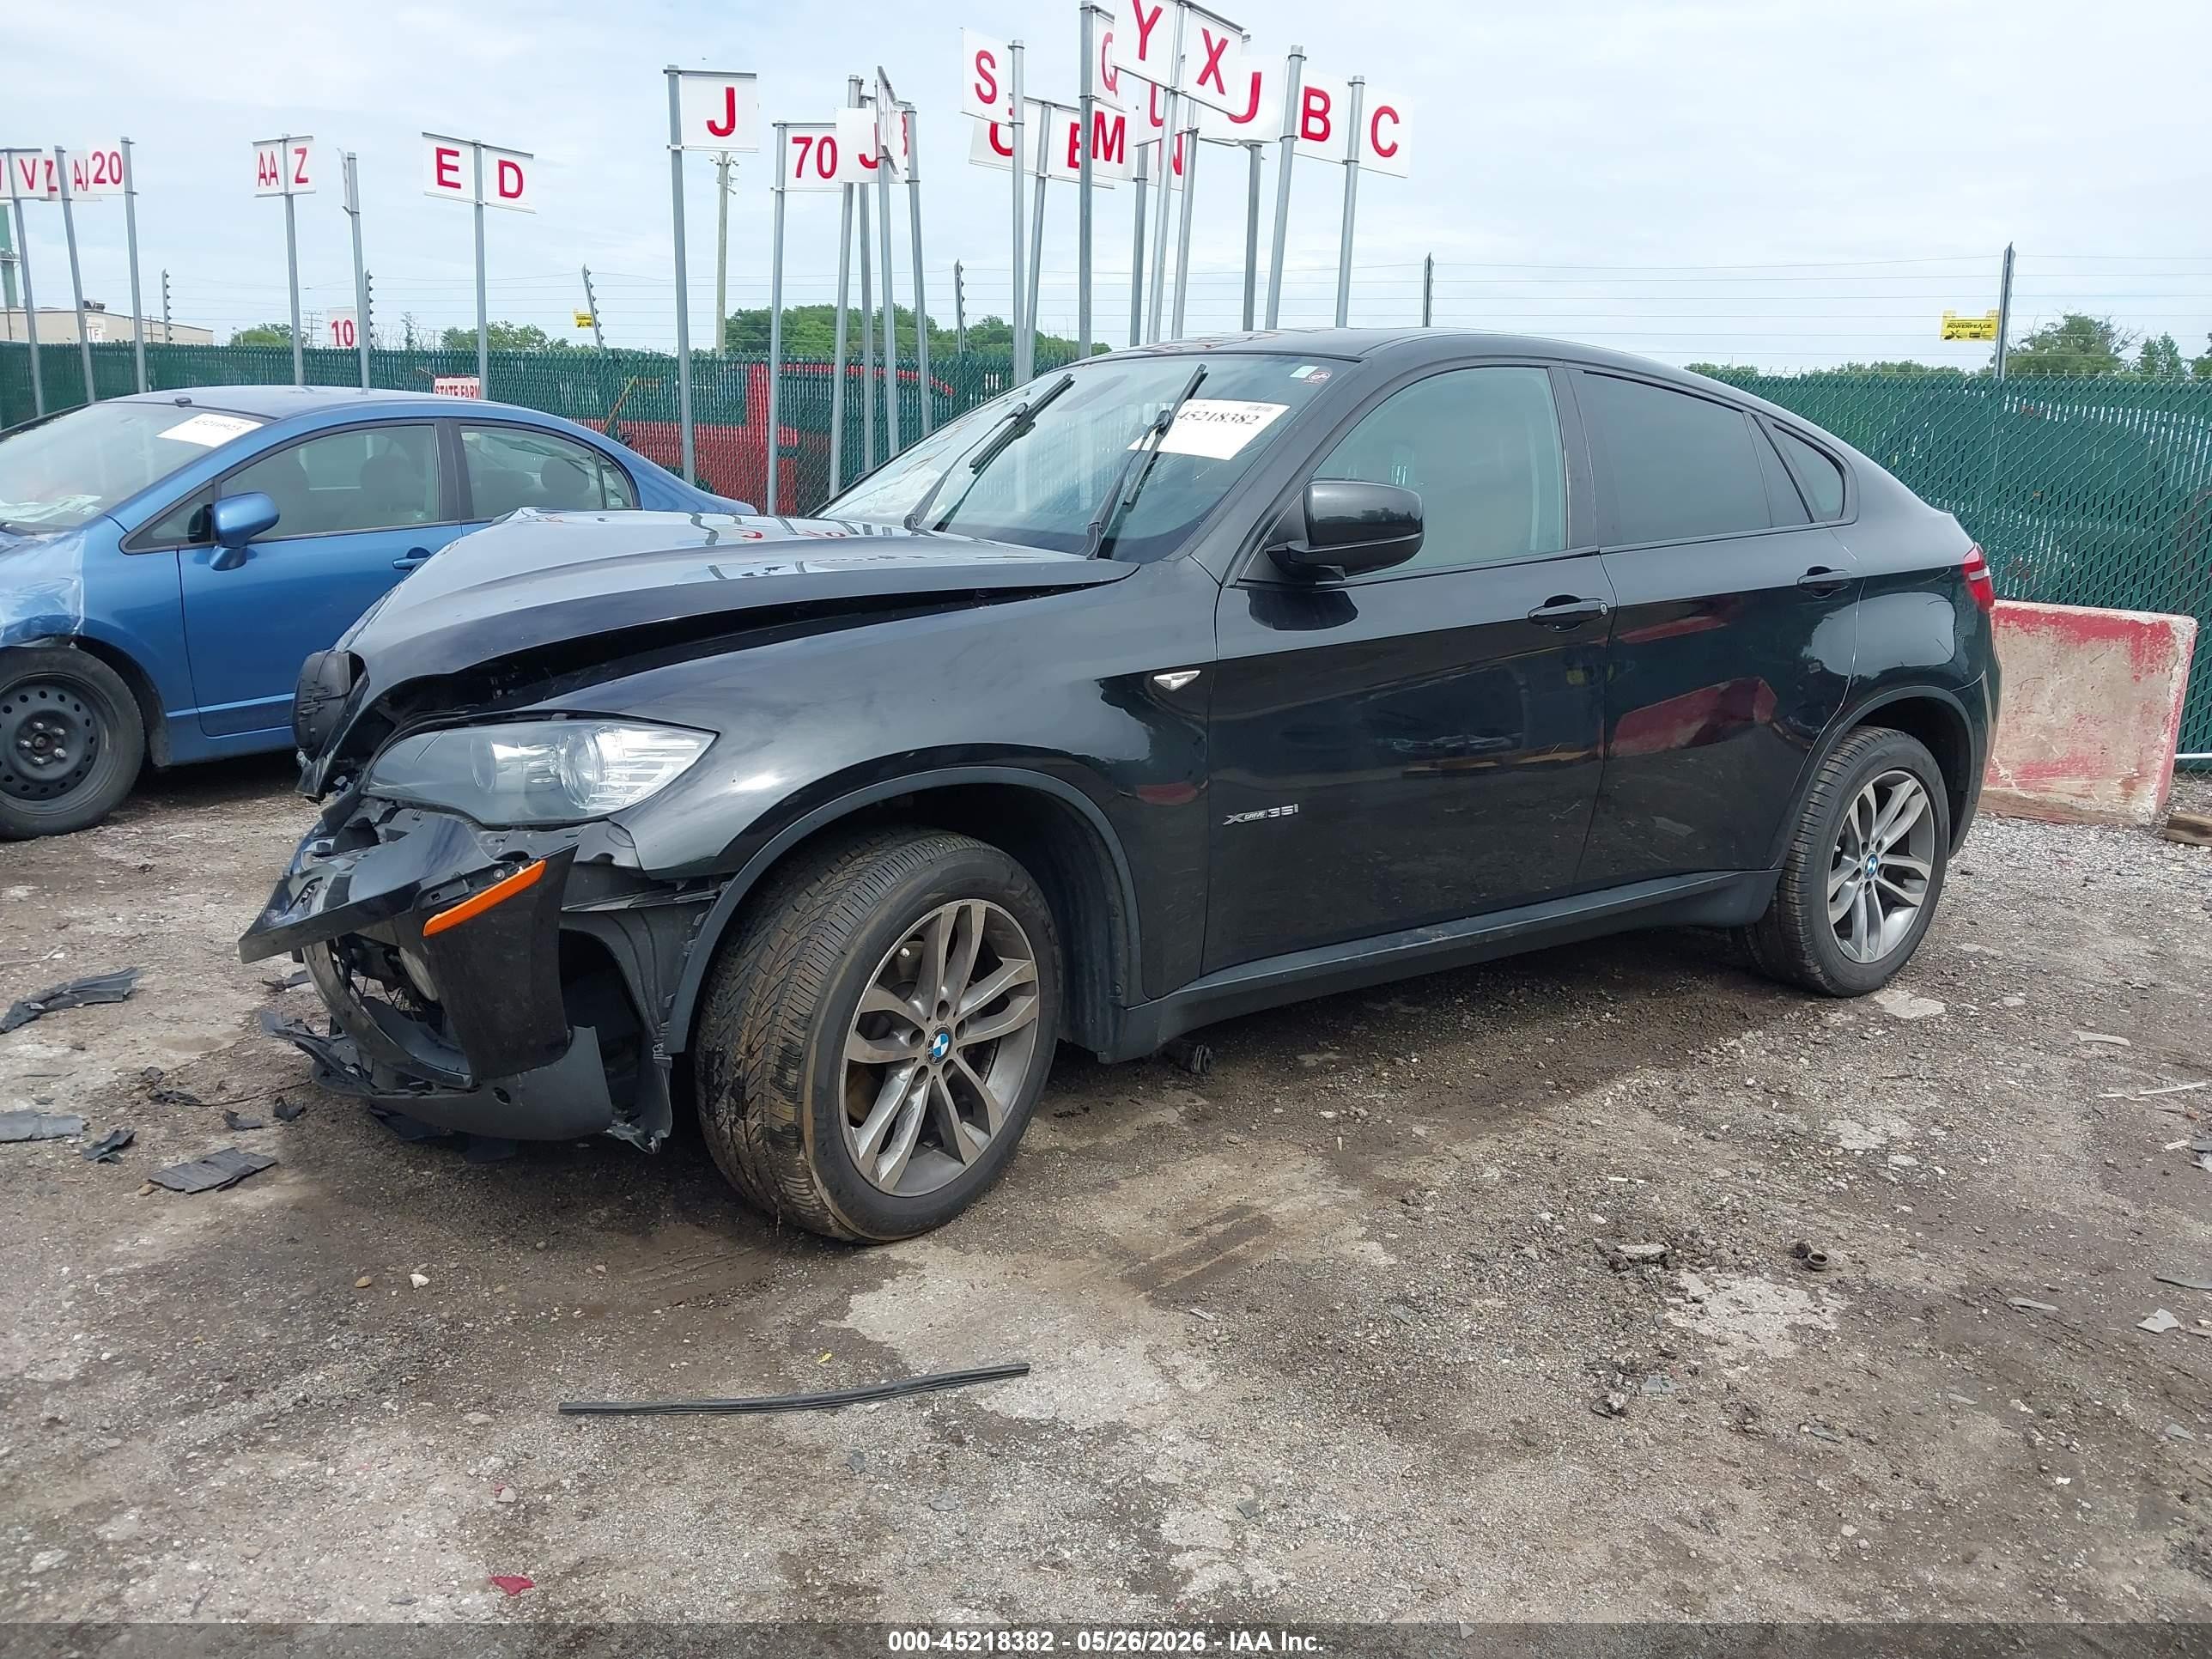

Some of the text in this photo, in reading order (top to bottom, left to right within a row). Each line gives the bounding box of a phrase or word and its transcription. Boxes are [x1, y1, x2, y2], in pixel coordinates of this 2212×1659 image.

[1132, 0, 1164, 62] Y
[975, 50, 998, 105] S
[1196, 27, 1229, 96] X
[706, 87, 737, 137] J
[1227, 71, 1262, 125] J
[1300, 86, 1332, 143] B
[1091, 109, 1127, 165] M
[1370, 105, 1401, 158] C
[19, 158, 37, 191] V
[91, 150, 123, 185] 20
[258, 150, 279, 187] AA
[294, 147, 309, 185] Z
[435, 147, 462, 190] E
[498, 159, 525, 199] D
[791, 136, 838, 180] 70
[331, 319, 355, 347] 10
[1177, 410, 1261, 425] 45218382
